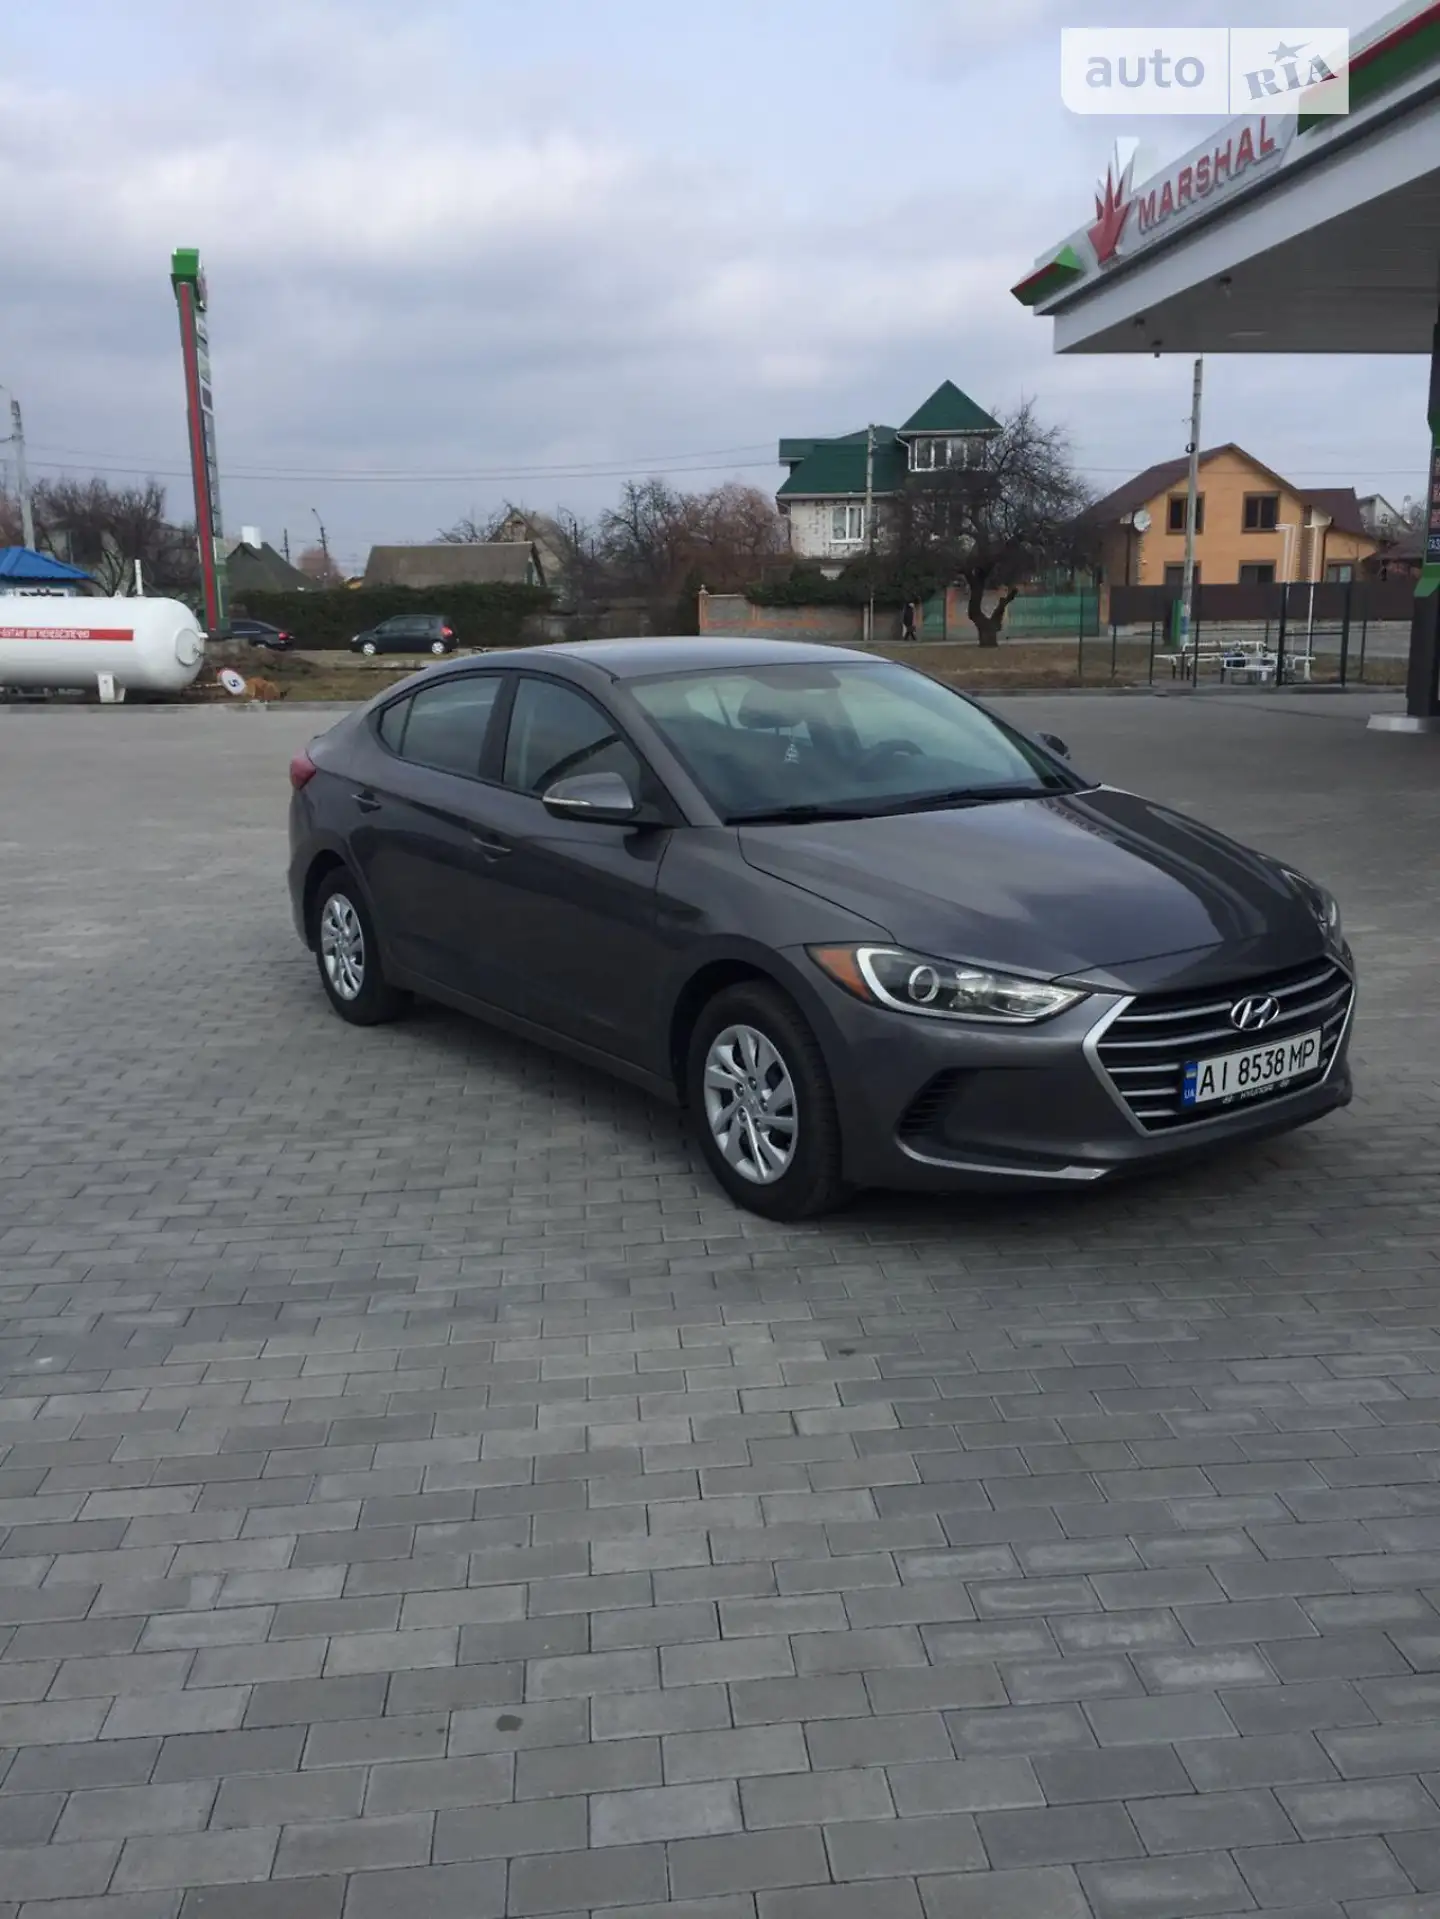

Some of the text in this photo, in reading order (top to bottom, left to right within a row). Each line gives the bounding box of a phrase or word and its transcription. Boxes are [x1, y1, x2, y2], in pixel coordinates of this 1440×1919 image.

[1138, 115, 1275, 232] MARSHAL
[1199, 1061, 1228, 1096] AI
[1238, 1048, 1285, 1085] 8538
[1289, 1038, 1315, 1072] MP
